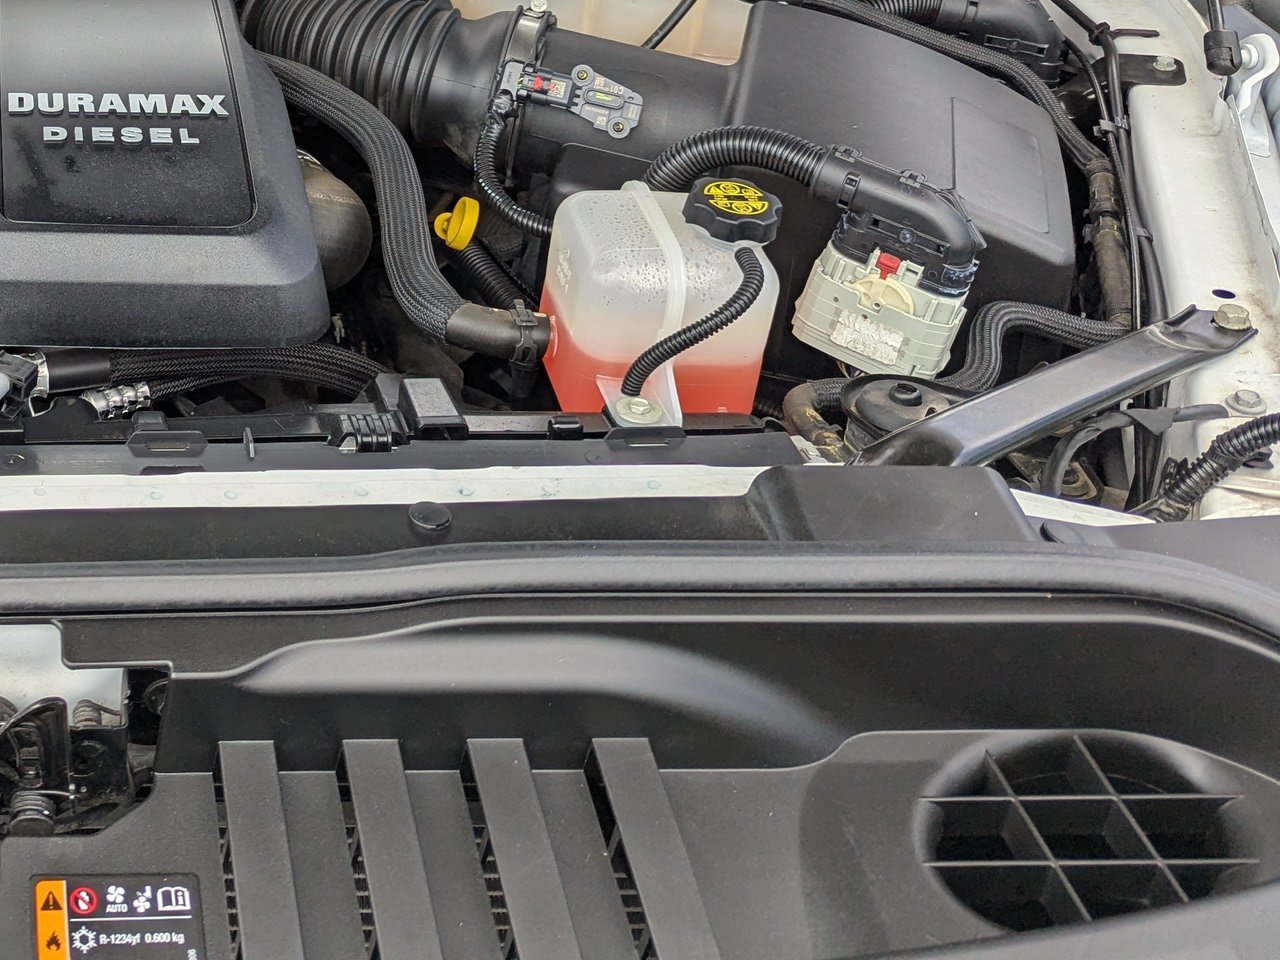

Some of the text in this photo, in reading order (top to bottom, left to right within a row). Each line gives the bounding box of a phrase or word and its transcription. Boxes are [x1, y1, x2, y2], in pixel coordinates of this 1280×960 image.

[8, 93, 229, 117] DURAMAX
[43, 126, 200, 145] DIESEL
[105, 903, 128, 913] AUTO
[99, 932, 185, 946] R-1234yf 0.600 kg
